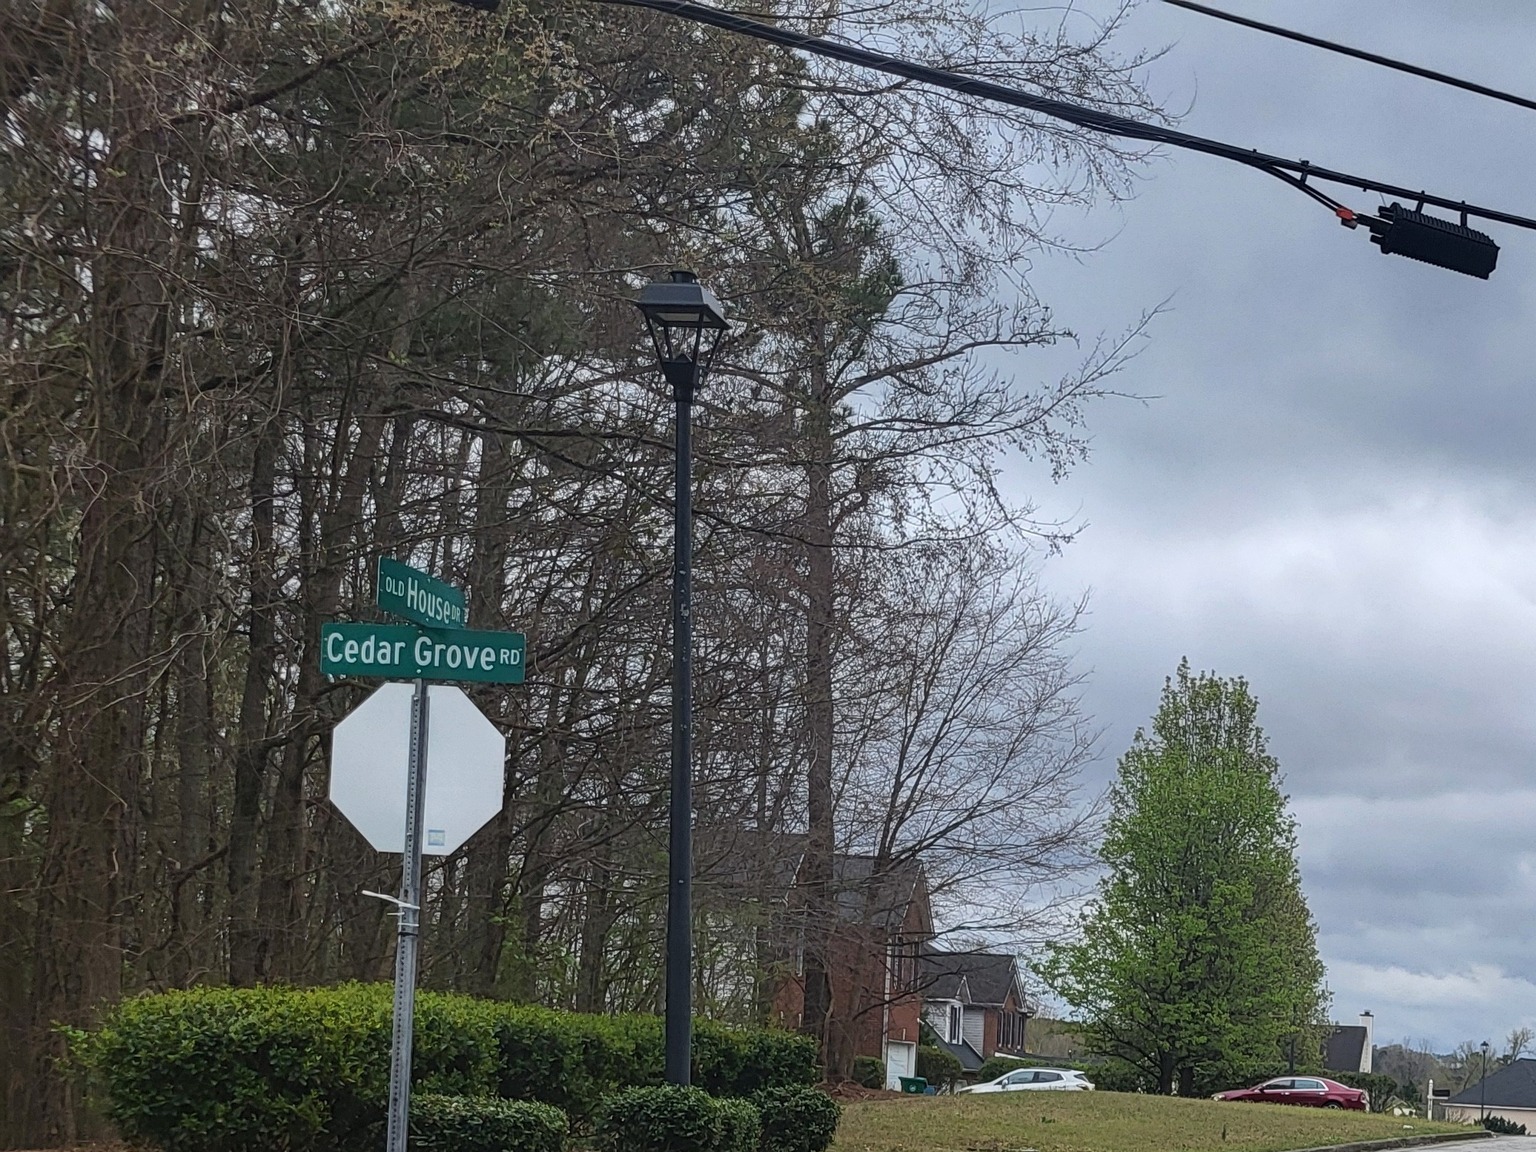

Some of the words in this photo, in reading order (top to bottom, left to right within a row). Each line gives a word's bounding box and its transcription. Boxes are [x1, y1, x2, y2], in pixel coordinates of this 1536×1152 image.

[385, 576, 405, 597] OLD
[407, 577, 451, 624] House
[451, 606, 461, 622] DR
[327, 632, 406, 665] Cedar
[414, 636, 496, 671] Grove
[500, 648, 520, 665] RD
